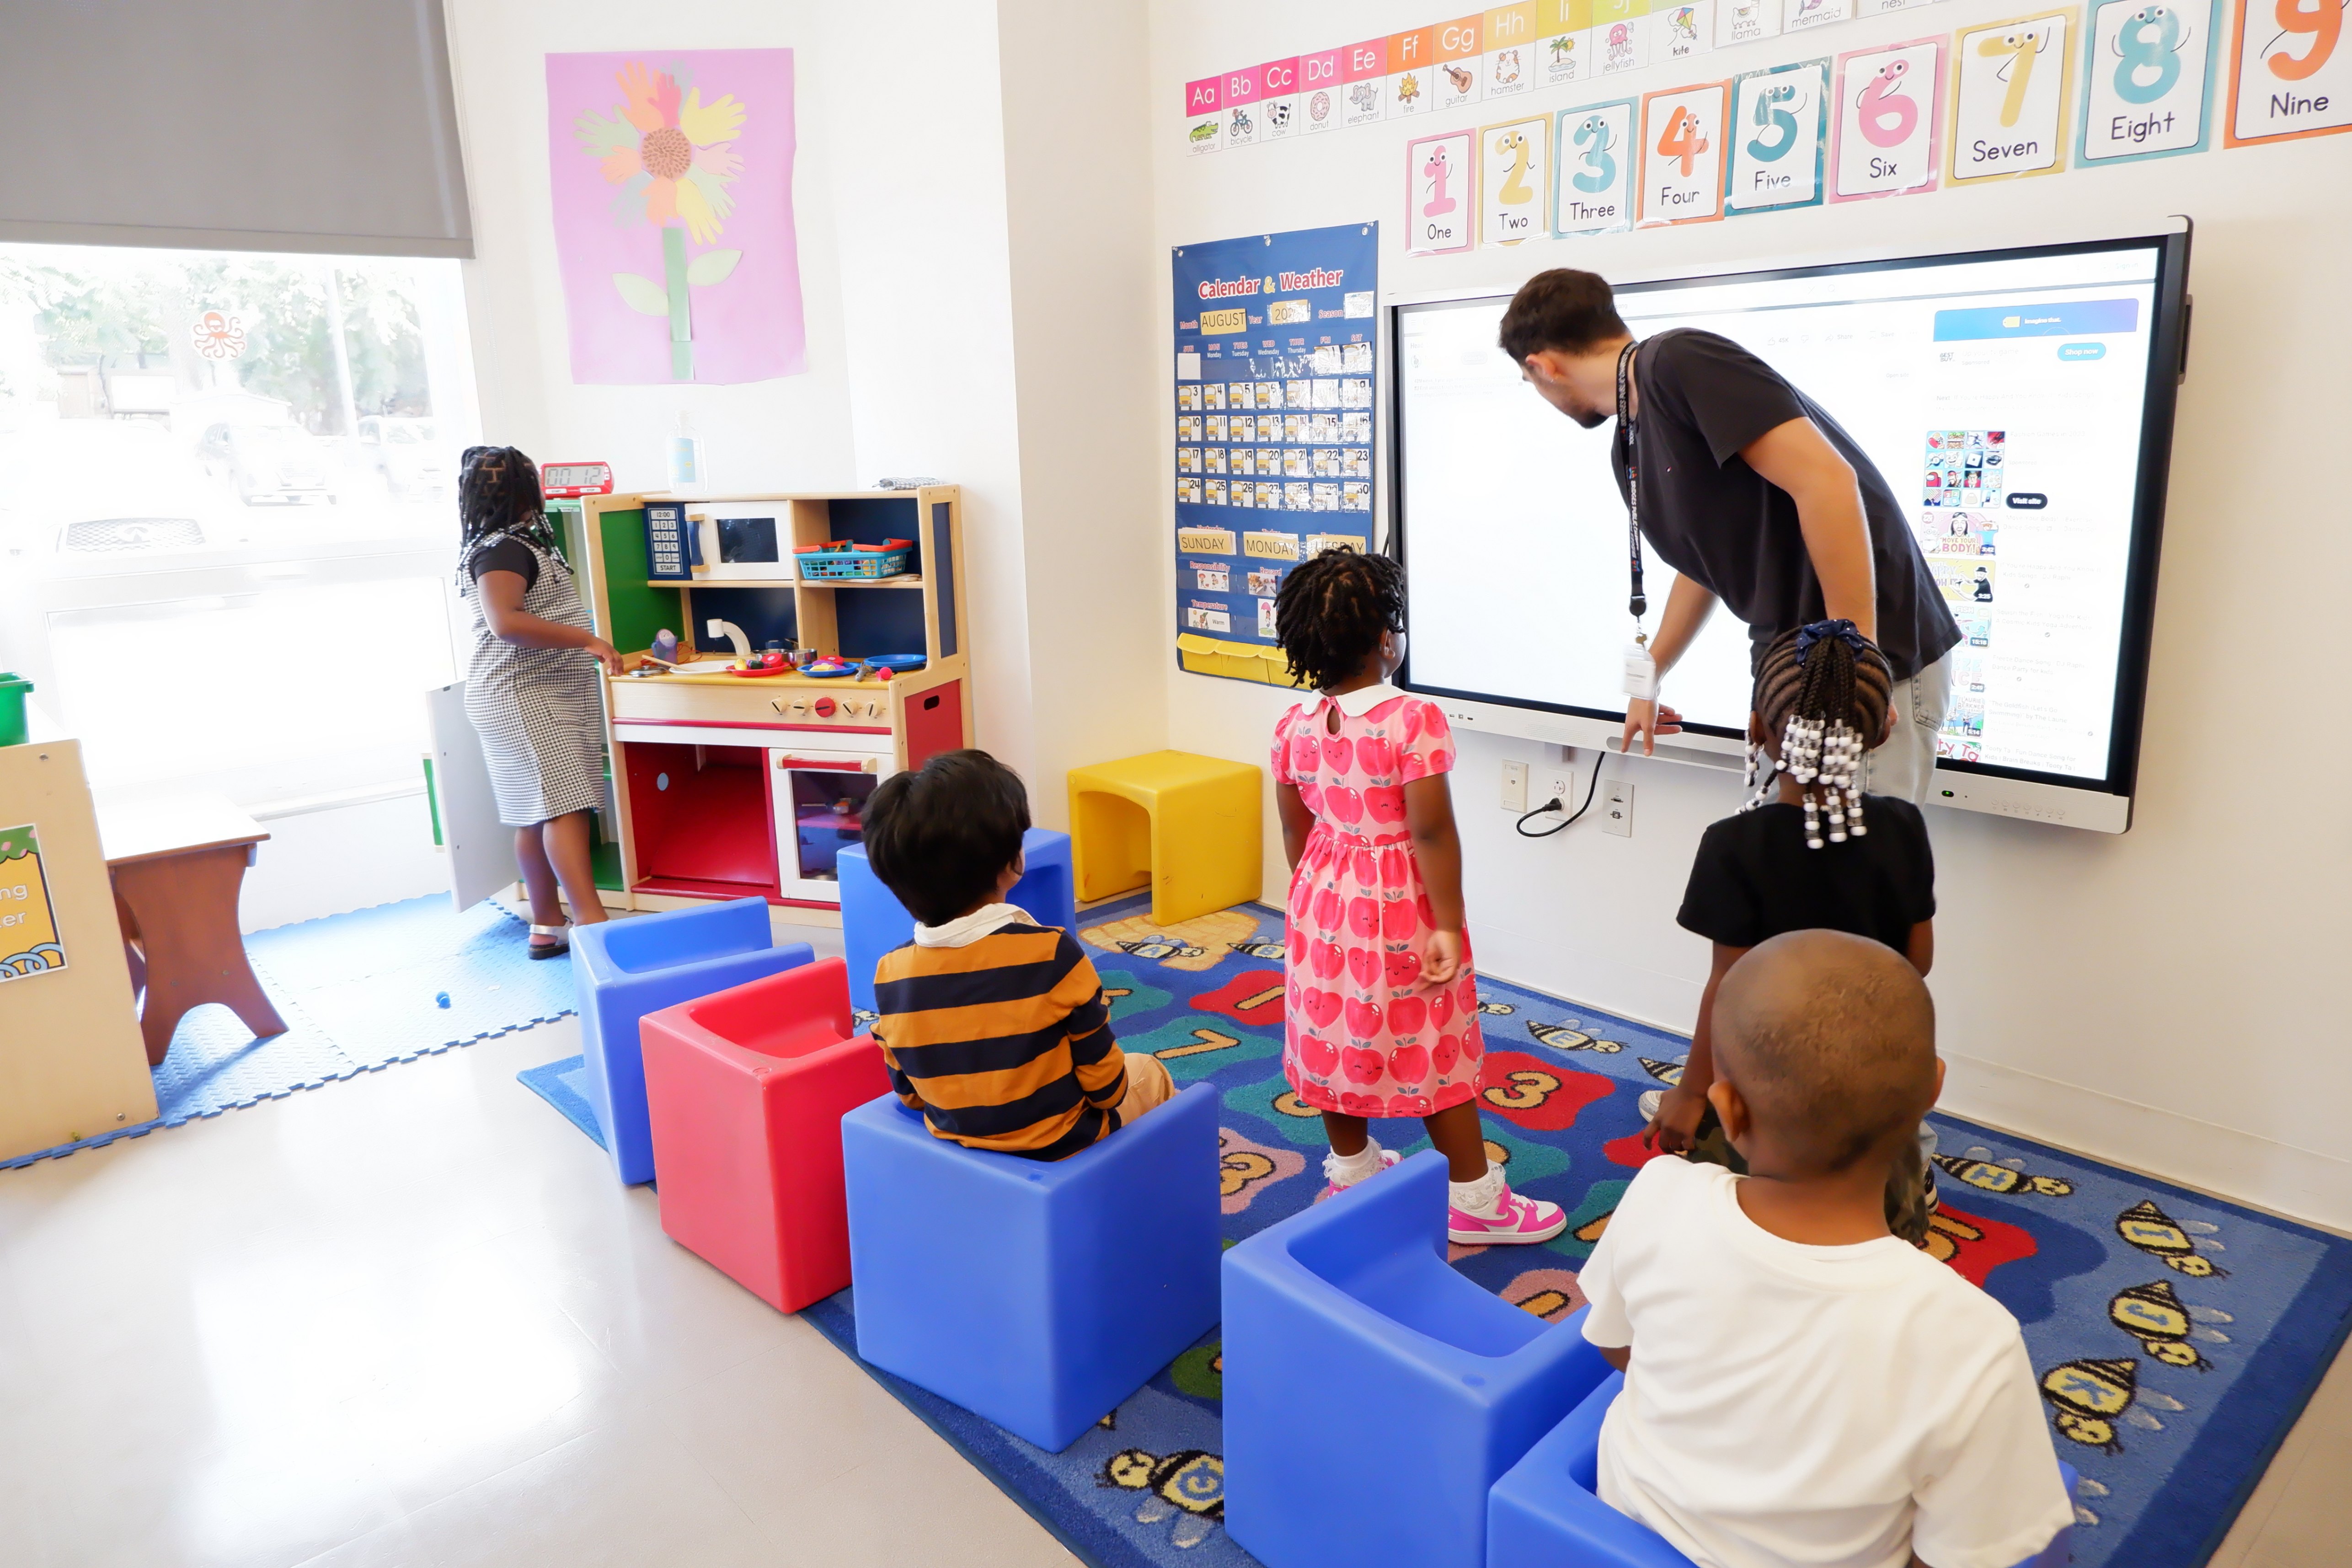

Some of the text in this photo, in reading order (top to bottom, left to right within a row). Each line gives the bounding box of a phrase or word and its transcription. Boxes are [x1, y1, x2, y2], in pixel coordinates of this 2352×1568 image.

[1791, 8, 1841, 28] mermaid
[1496, 14, 1525, 37] Hh
[1442, 27, 1475, 53] Gg
[1732, 27, 1761, 41] llama
[2267, 0, 2343, 81] 9
[1403, 35, 1419, 60] Ff
[1673, 45, 1690, 56] kite
[2113, 5, 2181, 104] 8
[1353, 49, 1376, 71] Ee
[1603, 57, 1635, 74] jellyfish
[1308, 57, 1334, 81] Dd
[1267, 68, 1292, 89] Cc
[1549, 70, 1575, 83] island
[1977, 32, 2040, 128] 7
[1231, 78, 1251, 98] Bb
[1491, 81, 1524, 96] hamster
[1192, 86, 1215, 106] Aa
[1445, 93, 1468, 107] guitar
[1403, 104, 1415, 114] fire
[1859, 59, 1918, 148] 6
[2270, 92, 2329, 118] Nine
[1348, 111, 1379, 124] elephant
[1747, 85, 1798, 162] 5
[1272, 129, 1287, 137] cow
[1310, 121, 1329, 131] donut
[2111, 112, 2176, 143] Eight
[1230, 135, 1252, 146] bicycle
[1657, 106, 1709, 177] 4
[1192, 142, 1216, 154] alligator
[1572, 115, 1616, 193] 3
[1972, 140, 2038, 162] Seven
[1495, 130, 1533, 205] 2
[1869, 158, 1898, 178] Six
[1423, 145, 1456, 218] 1
[1755, 171, 1791, 191] Five
[1661, 187, 1700, 206] Four
[1570, 202, 1615, 220] Three
[1499, 213, 1528, 230] Two
[1427, 223, 1452, 240] One
[1198, 268, 1343, 300] Calendar & Weather
[1180, 312, 1245, 330] Month AUGUST
[1248, 316, 1262, 324] Year
[1318, 310, 1343, 319] Season
[1361, 344, 1367, 355] 2
[1193, 387, 1198, 396] 3
[1217, 385, 1222, 395] 4
[1245, 384, 1250, 394] 5
[1193, 417, 1200, 427] 10
[1220, 417, 1225, 426] 11
[1245, 417, 1252, 427] 12
[1272, 416, 1279, 426] 13
[1327, 417, 1336, 427] 15
[1193, 449, 1199, 459] 17
[1218, 450, 1224, 459] 18
[1245, 450, 1252, 460] 19
[1269, 450, 1279, 460] 20
[1299, 450, 1305, 460] 21
[1327, 450, 1338, 460] 22
[1357, 450, 1368, 461] 23
[1190, 480, 1200, 489] 24
[1217, 482, 1225, 491] 25
[1243, 483, 1253, 493] 26
[1269, 484, 1278, 494] 27
[1358, 484, 1368, 495] 30
[1181, 537, 1224, 550] SUNDAY
[1246, 540, 1295, 556] MONDAY
[1190, 561, 1230, 573] Responsibility
[1260, 567, 1282, 576] Reward
[1192, 599, 1228, 610] Temperature
[1481, 1070, 1562, 1109] 3
[2059, 1371, 2116, 1405] K
